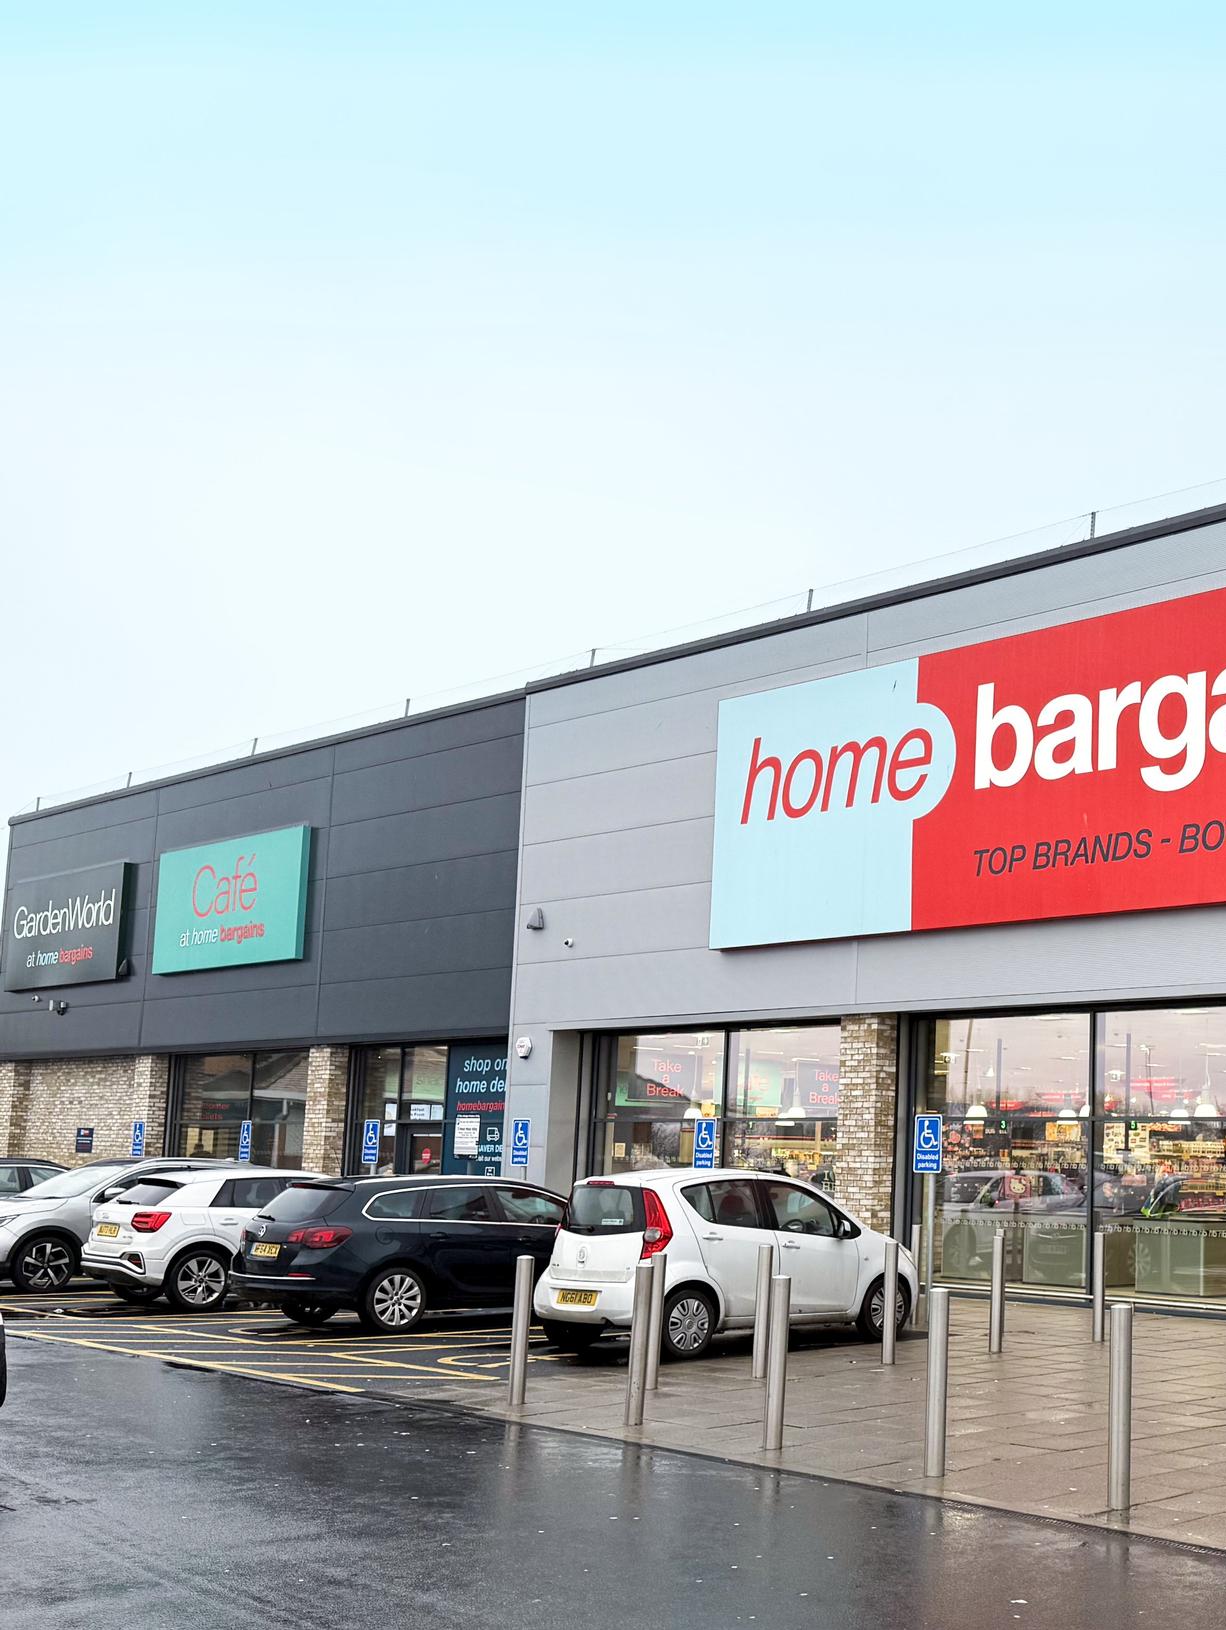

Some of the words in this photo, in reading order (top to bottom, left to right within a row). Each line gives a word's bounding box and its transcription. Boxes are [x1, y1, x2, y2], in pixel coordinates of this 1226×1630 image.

[741, 727, 933, 826] home
[973, 844, 1027, 877] TOP
[1032, 828, 1153, 870] BRANDS
[192, 853, 259, 918] Café
[13, 888, 116, 939] GardenWorld
[179, 929, 189, 947] at
[191, 928, 218, 945] home
[219, 920, 265, 944] bargains
[26, 952, 35, 968] at
[36, 950, 58, 966] home
[59, 944, 93, 965] bargains
[463, 1056, 491, 1075] shop
[651, 1058, 682, 1073] Take
[455, 1077, 487, 1093] home
[662, 1074, 670, 1083] a
[815, 1070, 839, 1081] Take
[646, 1083, 685, 1097] Break
[822, 1083, 830, 1092] a
